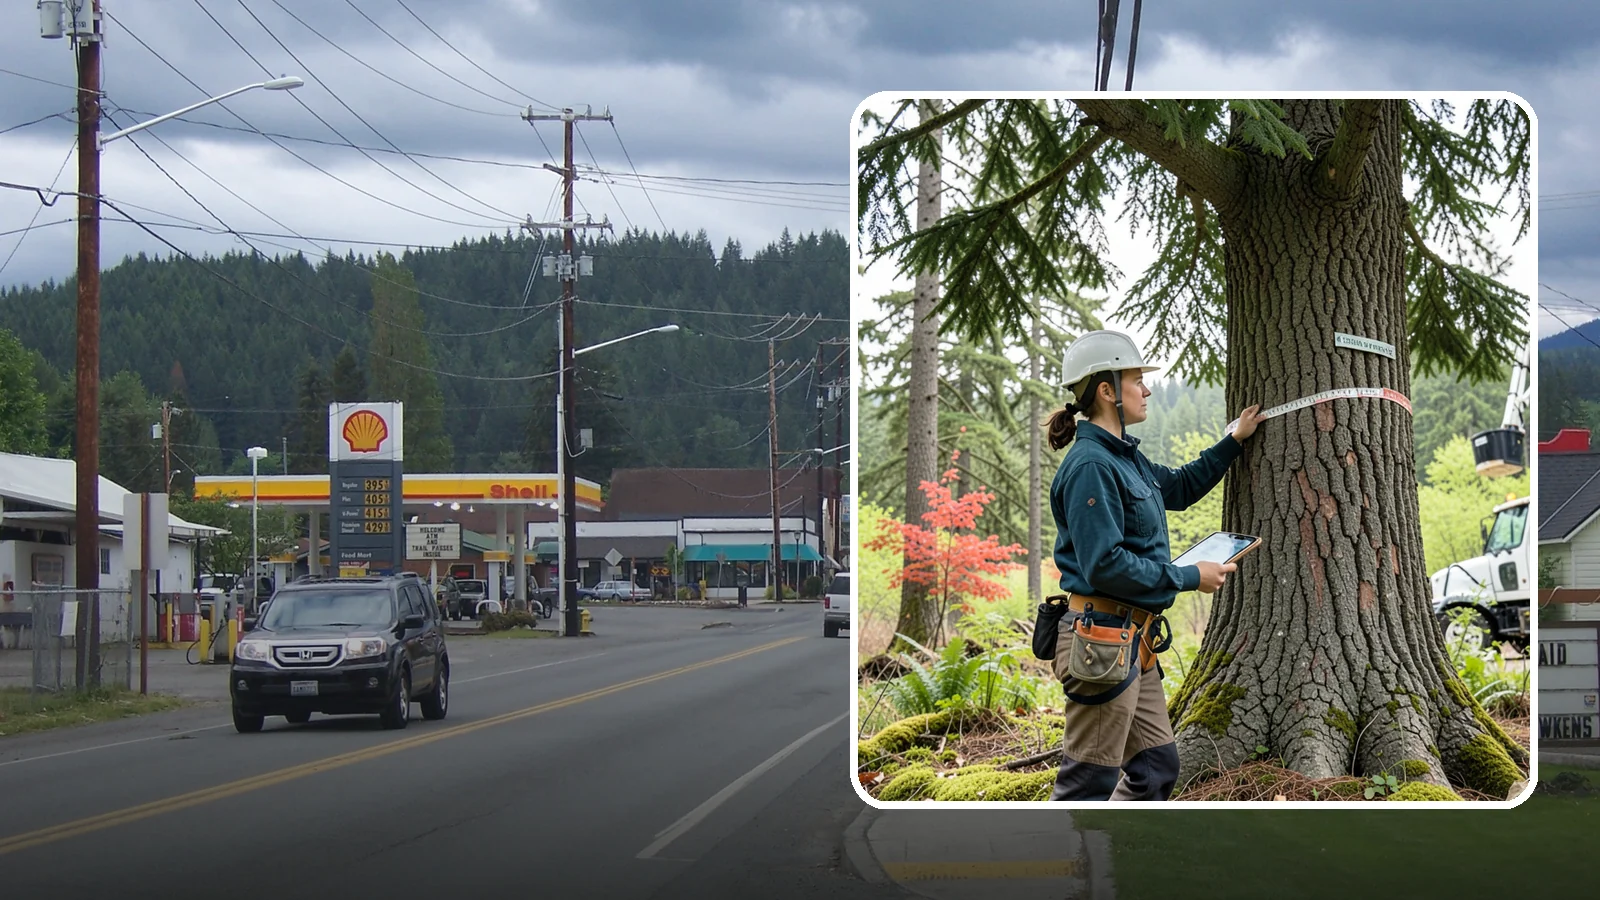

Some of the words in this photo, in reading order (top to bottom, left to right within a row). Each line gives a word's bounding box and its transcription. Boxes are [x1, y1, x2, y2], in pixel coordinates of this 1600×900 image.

[366, 480, 384, 490] 395
[490, 484, 547, 499] Shell
[366, 494, 384, 504] 405
[366, 508, 384, 518] 415
[1538, 643, 1567, 665] AID
